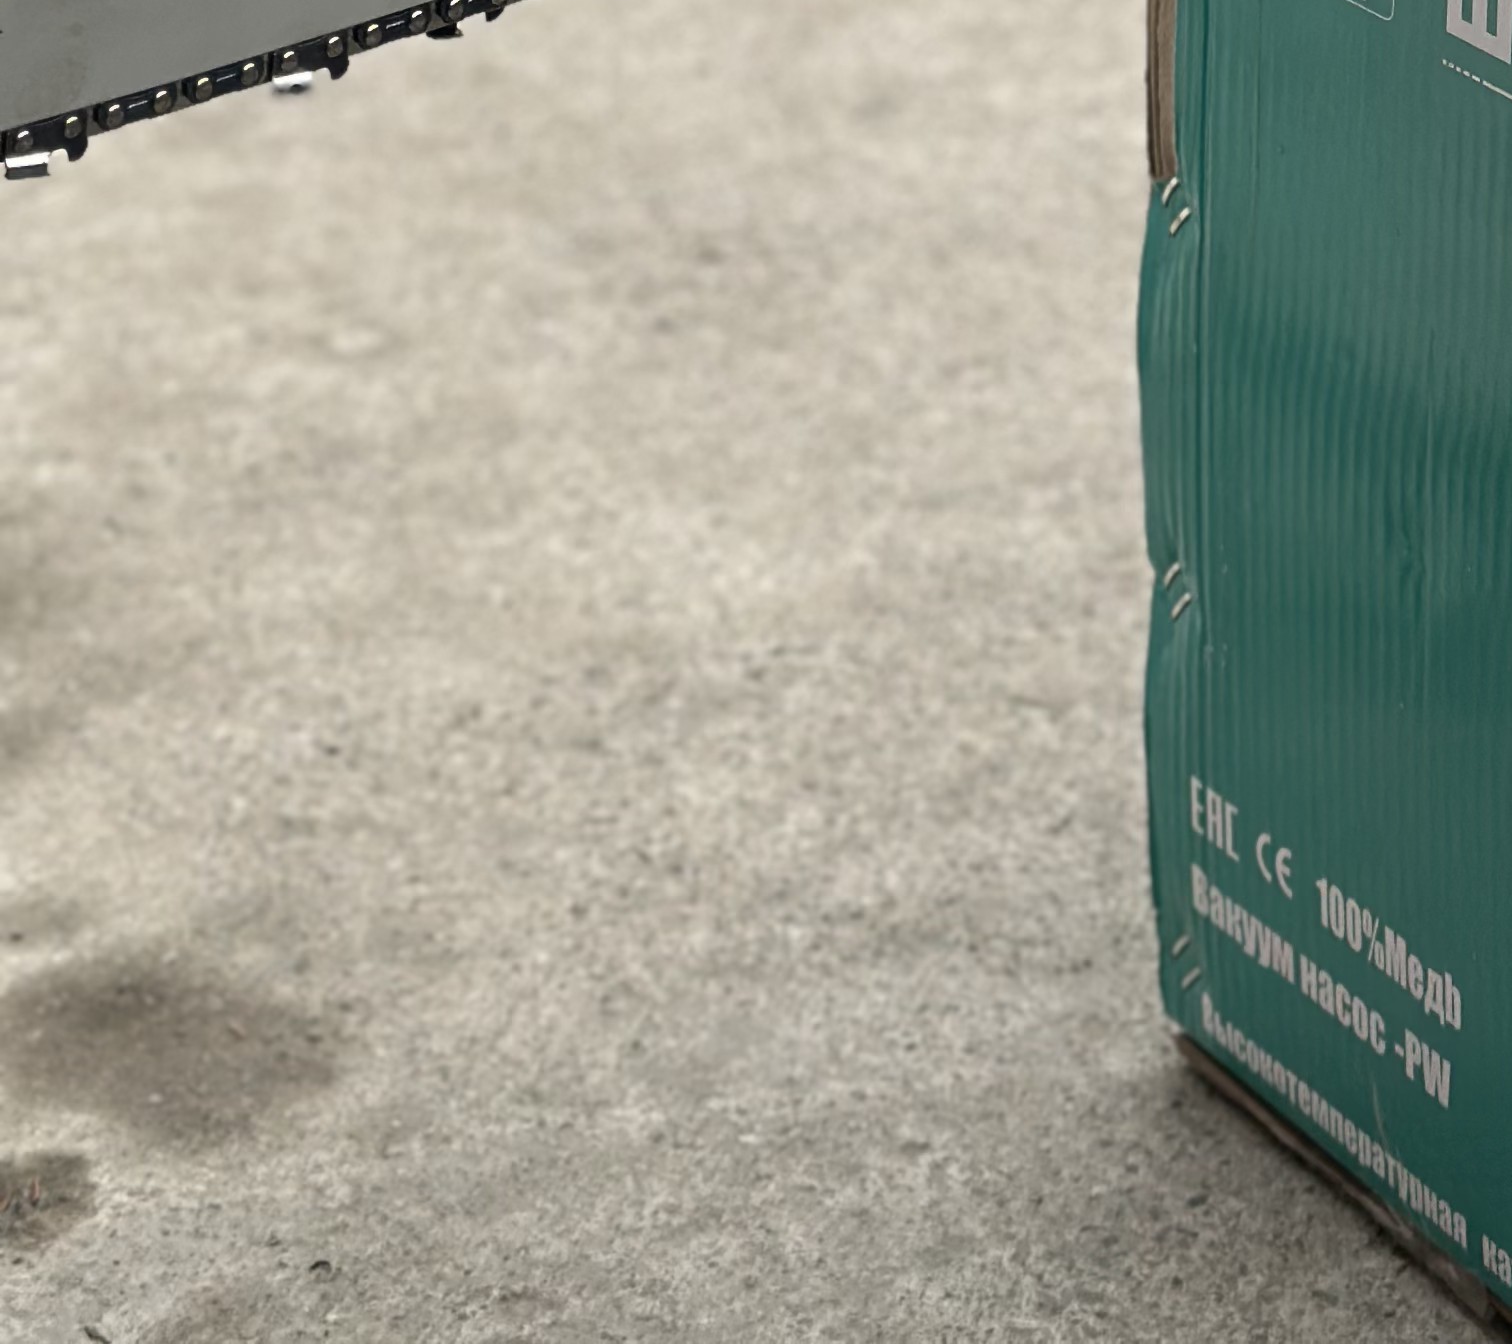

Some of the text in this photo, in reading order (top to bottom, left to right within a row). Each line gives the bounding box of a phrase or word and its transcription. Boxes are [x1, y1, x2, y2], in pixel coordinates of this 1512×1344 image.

[1191, 863, 1452, 1109] Вакуум насос -PW
[1315, 876, 1462, 1031] 100%Медь
